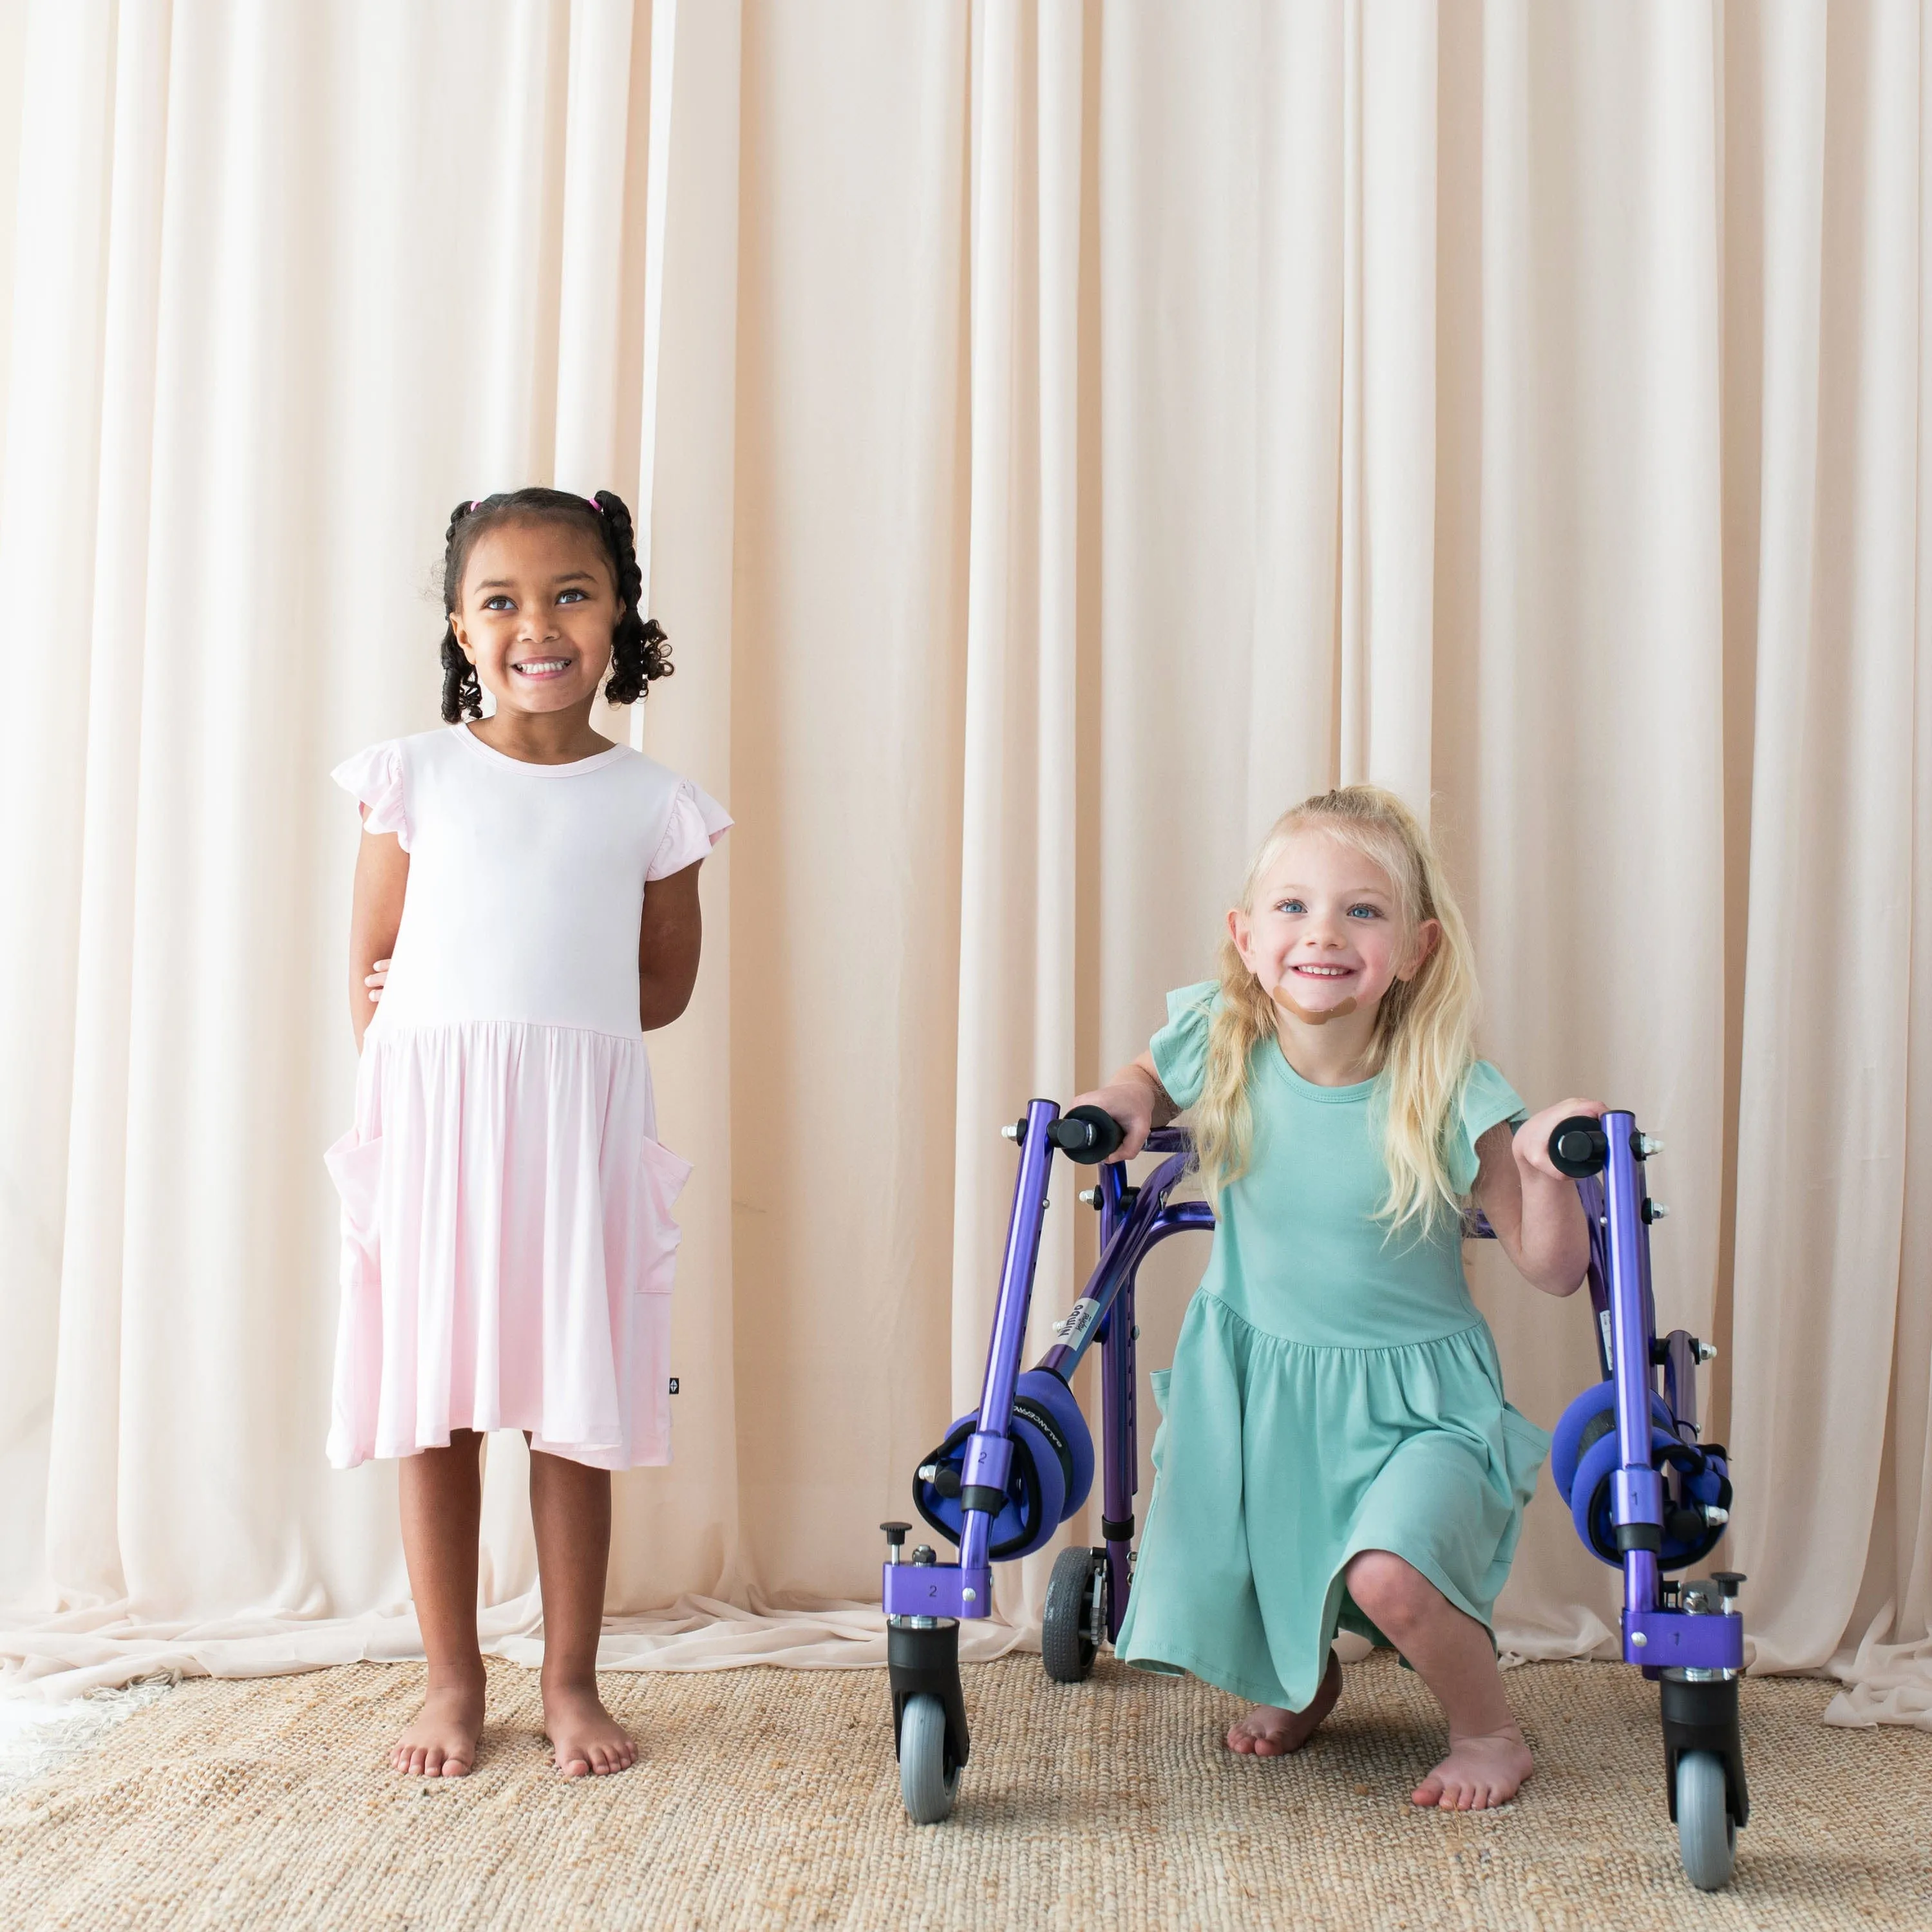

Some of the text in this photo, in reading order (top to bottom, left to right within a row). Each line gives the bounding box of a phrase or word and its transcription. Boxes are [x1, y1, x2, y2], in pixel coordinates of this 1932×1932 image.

[1057, 1304, 1083, 1338] Nimbo
[978, 1452, 987, 1464] 2
[1631, 1492, 1638, 1506] 1
[929, 1585, 937, 1597] 2
[1672, 1631, 1680, 1646] 1
